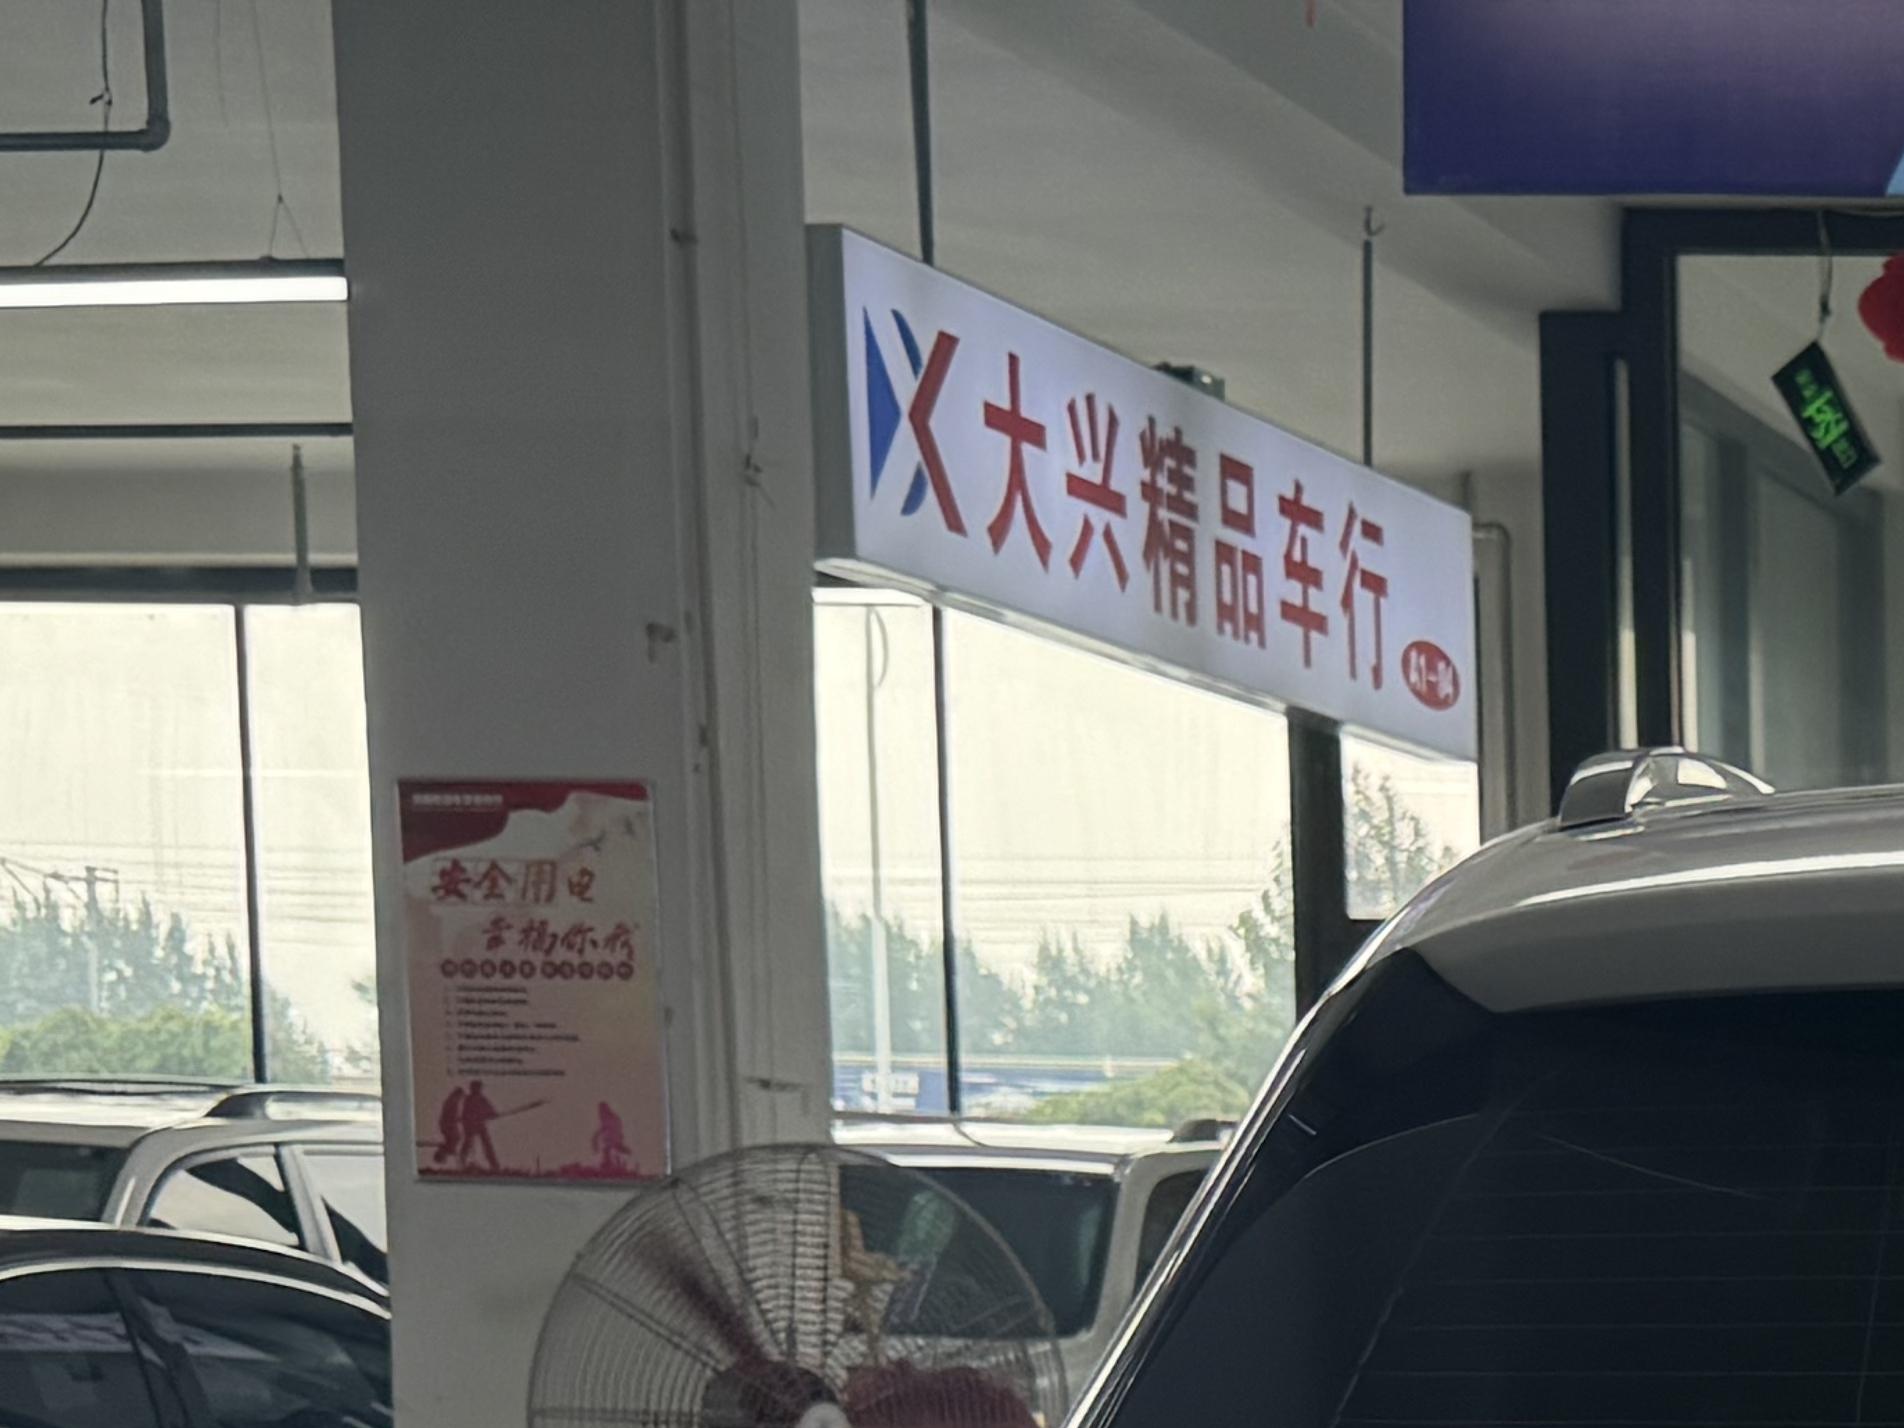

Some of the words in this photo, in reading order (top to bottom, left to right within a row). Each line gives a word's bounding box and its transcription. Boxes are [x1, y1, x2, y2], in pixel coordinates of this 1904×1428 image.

[983, 351, 1389, 691] 大兴精品车行
